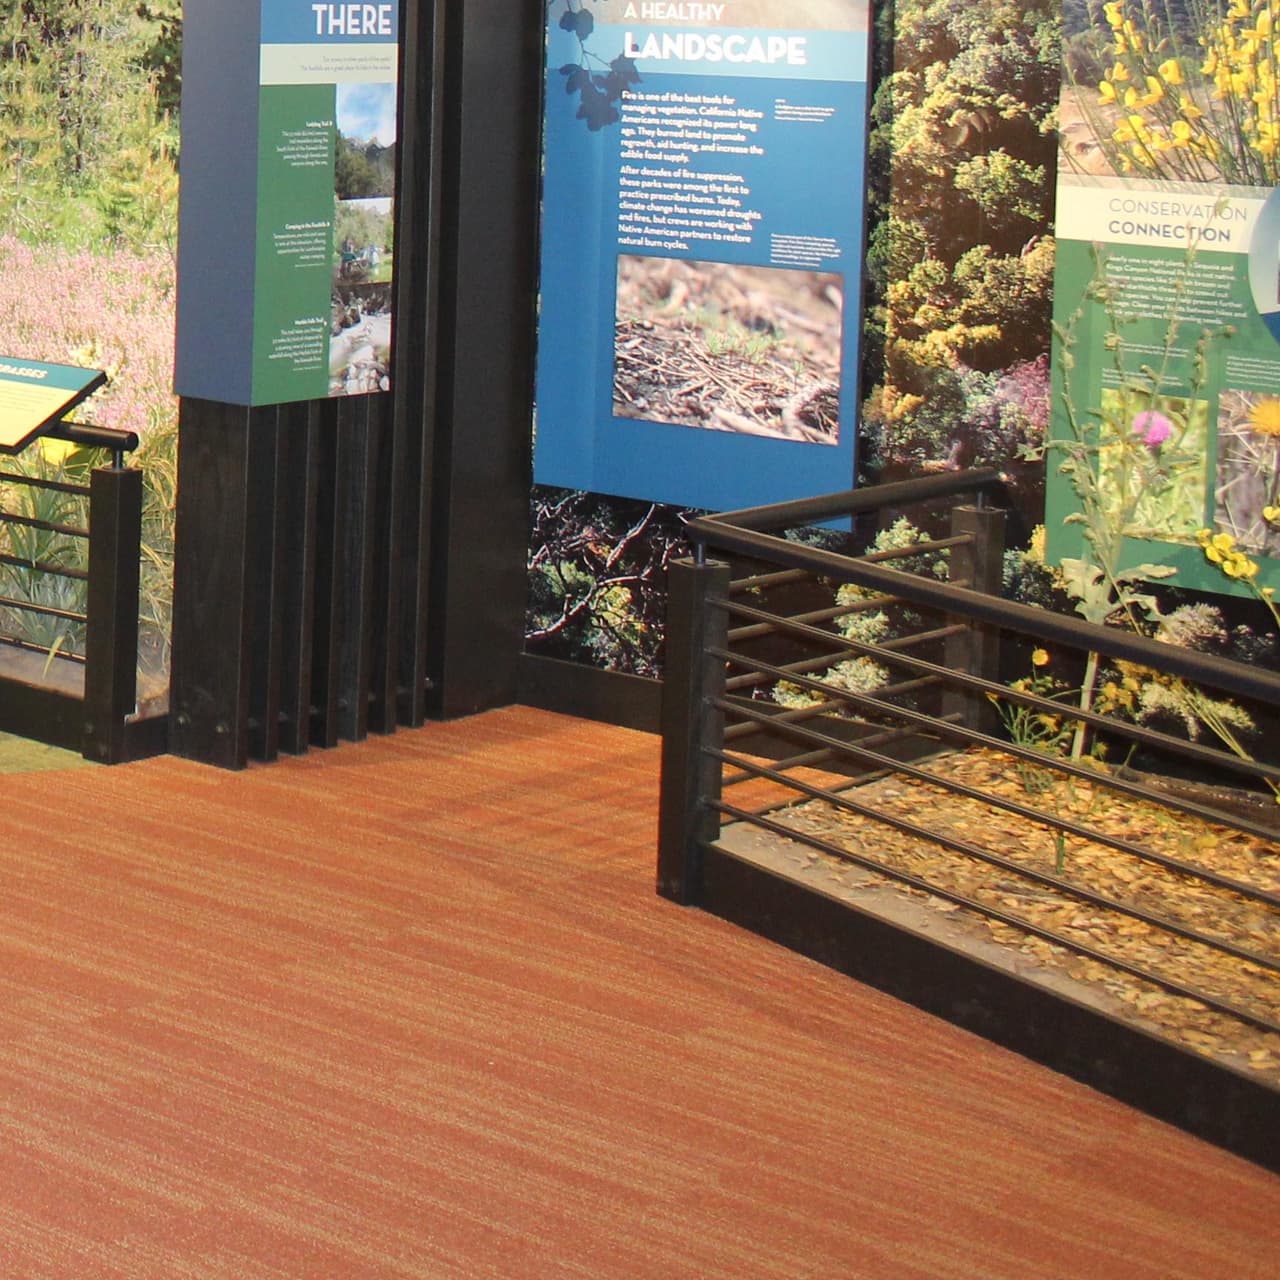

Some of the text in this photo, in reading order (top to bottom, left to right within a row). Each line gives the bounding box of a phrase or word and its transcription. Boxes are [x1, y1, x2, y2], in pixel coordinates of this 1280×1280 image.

[624, 1, 726, 21] A HEALTHY
[312, 4, 392, 35] THERE
[624, 31, 808, 66] LANDSCAPE
[622, 91, 637, 100] Fire
[685, 94, 700, 102] best
[702, 95, 721, 103] tools
[622, 102, 656, 114] managing
[699, 106, 736, 116] California
[738, 108, 763, 117] Native
[622, 114, 659, 124] Americans
[662, 116, 700, 128] recognized
[714, 121, 738, 130] power
[740, 120, 757, 131] long
[638, 127, 655, 138] They
[657, 128, 684, 137] burned
[686, 129, 701, 138] land
[713, 131, 746, 143] promote
[621, 149, 643, 158] edible
[645, 150, 662, 159] food
[717, 143, 748, 153] increase
[621, 165, 639, 174] After
[641, 167, 671, 176] decades
[683, 169, 695, 177] fire
[620, 177, 640, 186] these
[642, 178, 662, 190] parks
[683, 183, 708, 193] among
[724, 184, 739, 193] first
[620, 189, 649, 201] practice
[651, 191, 690, 204] prescribed
[619, 200, 645, 209] climate
[647, 202, 673, 214] change
[689, 205, 725, 215] worsened
[727, 208, 762, 221] droughts
[1109, 198, 1247, 221] CONSERVATION
[704, 218, 734, 230] working
[736, 220, 752, 229] with
[1108, 221, 1231, 242] CONNECTION
[618, 235, 643, 244] natural
[645, 237, 662, 246] burn
[619, 223, 641, 232] Native
[643, 225, 678, 236] American
[680, 228, 712, 241] partners
[723, 232, 751, 242] restore
